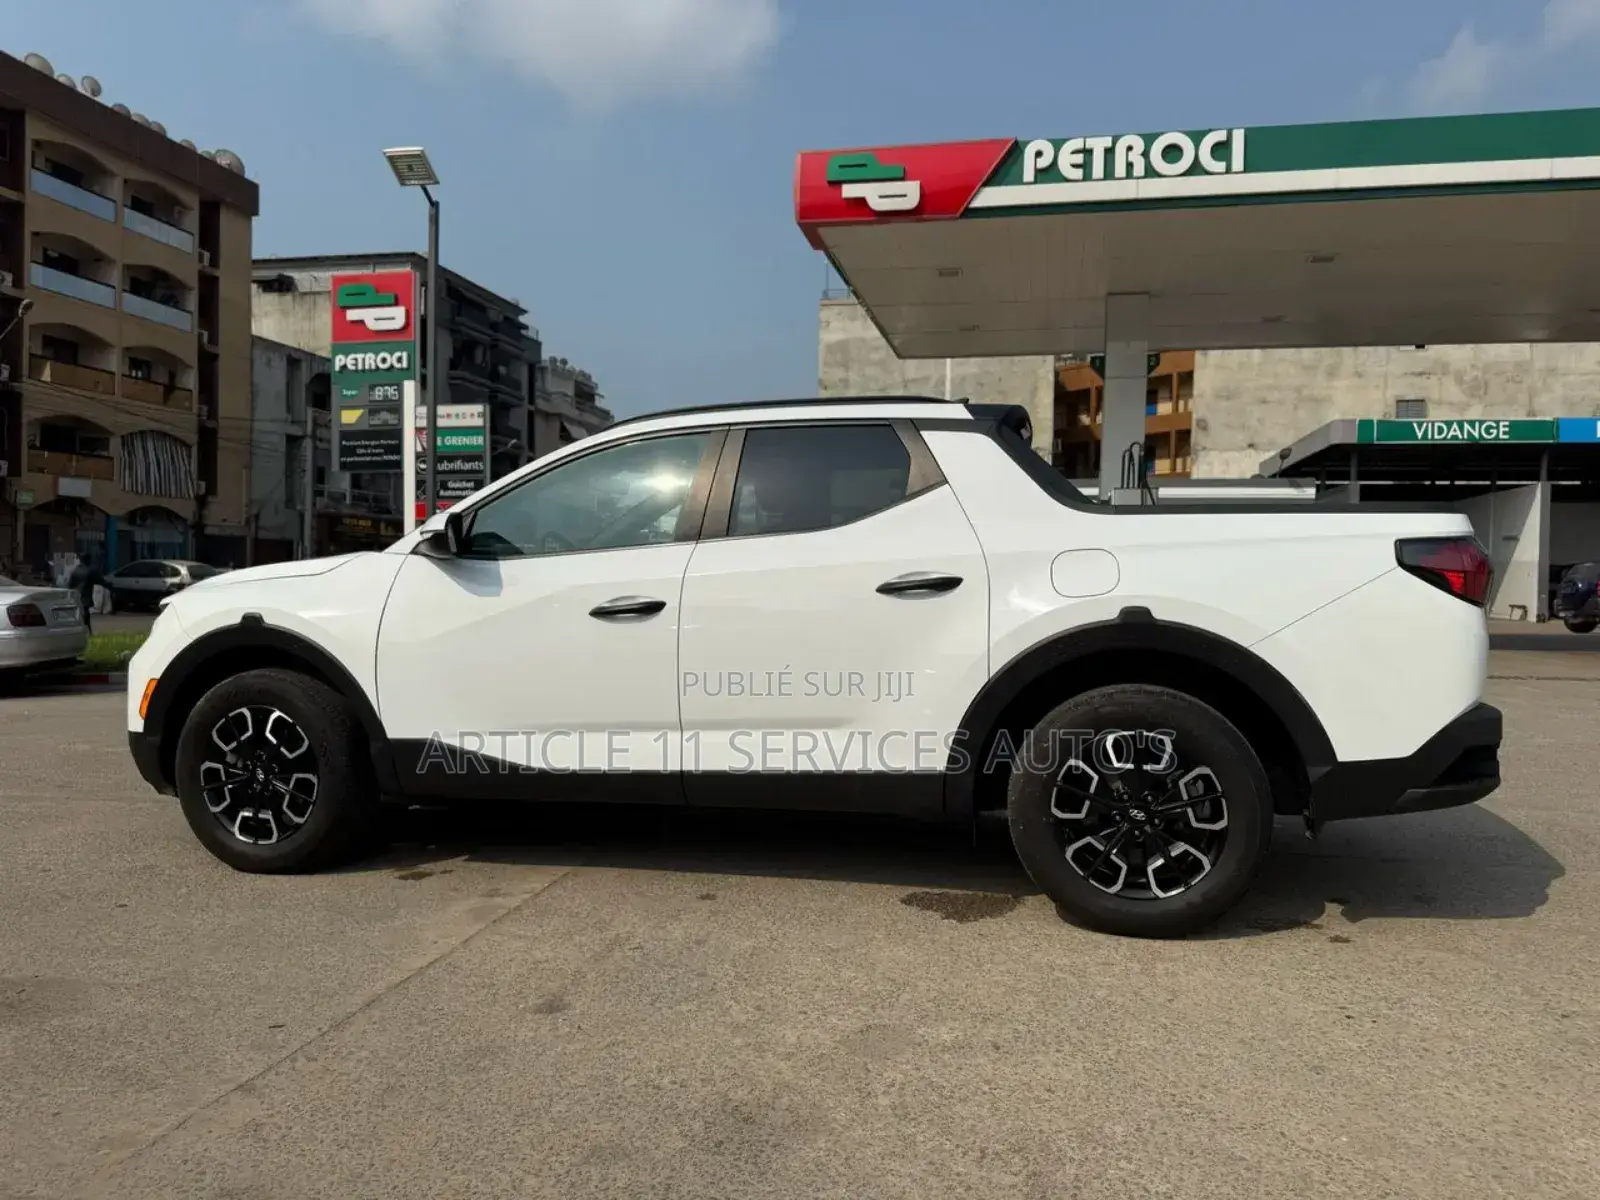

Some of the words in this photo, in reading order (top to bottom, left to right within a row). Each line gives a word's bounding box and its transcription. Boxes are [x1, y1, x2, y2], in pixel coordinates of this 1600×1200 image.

[1023, 128, 1245, 183] PETROCI
[335, 351, 408, 371] PETROCI
[375, 386, 399, 400] 875
[1413, 421, 1510, 440] VIDANGE
[444, 435, 484, 446] GRENIER
[437, 459, 484, 471] ubrifiants
[448, 481, 475, 489] Guichet
